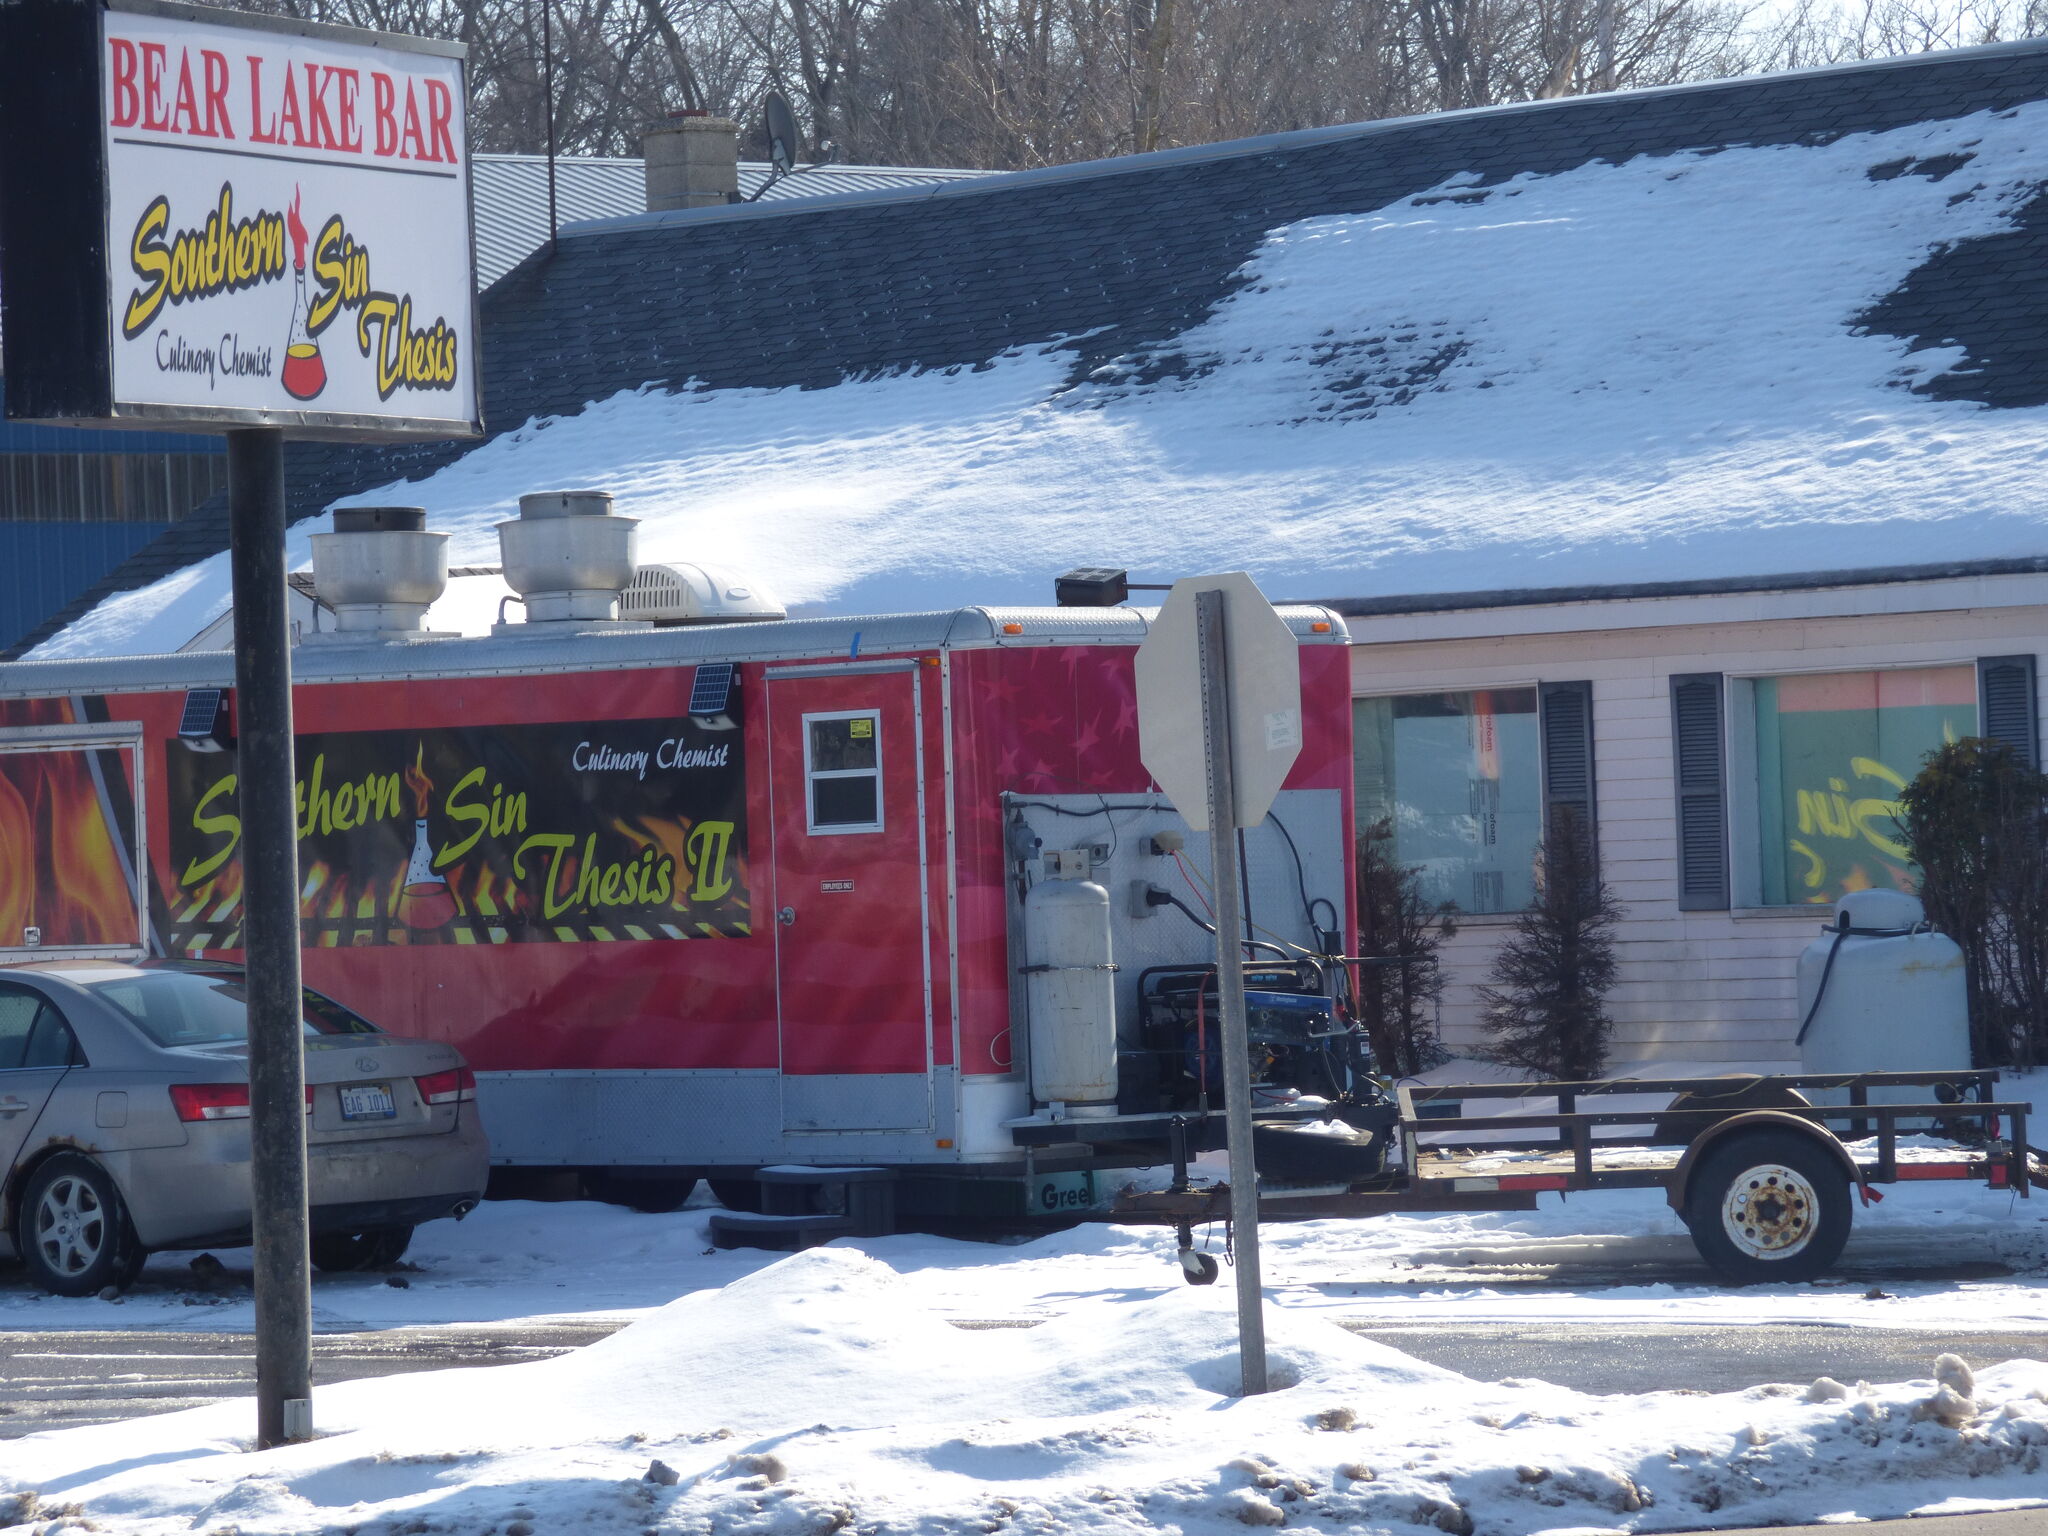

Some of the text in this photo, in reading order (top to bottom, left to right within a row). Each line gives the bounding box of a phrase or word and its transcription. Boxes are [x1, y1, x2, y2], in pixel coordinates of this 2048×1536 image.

[109, 38, 458, 164] BEAR LAKE BAR
[122, 180, 370, 341] Southern Sin
[156, 329, 271, 391] Culinary Chemist
[357, 291, 457, 402] Thesis
[573, 738, 728, 781] Culinary Chemist
[181, 753, 526, 886] Sthern Sin
[513, 821, 734, 920] Thesis II
